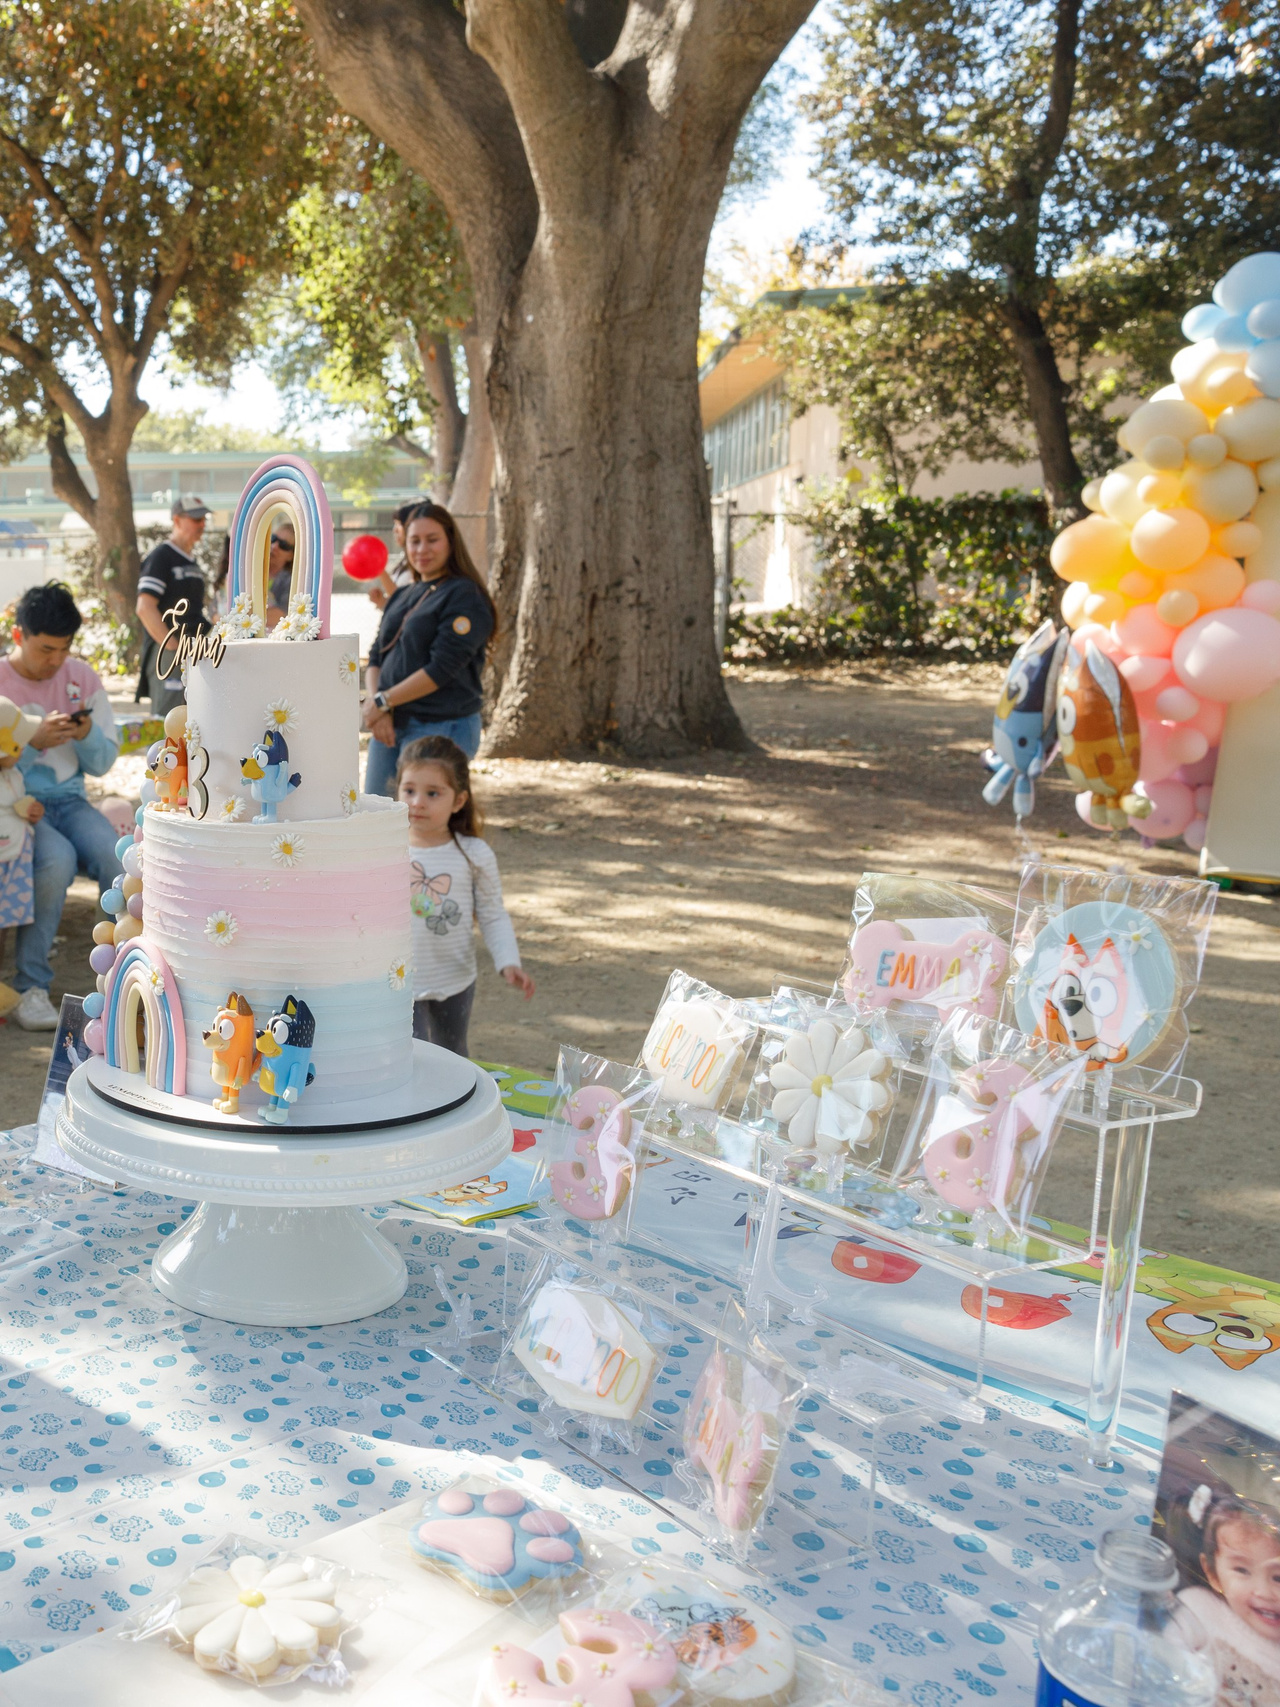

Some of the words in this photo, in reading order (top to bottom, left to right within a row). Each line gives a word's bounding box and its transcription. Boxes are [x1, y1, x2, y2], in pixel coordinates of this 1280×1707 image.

[156, 598, 226, 680] Emma
[187, 746, 210, 820] 3
[876, 949, 961, 996] EMMA
